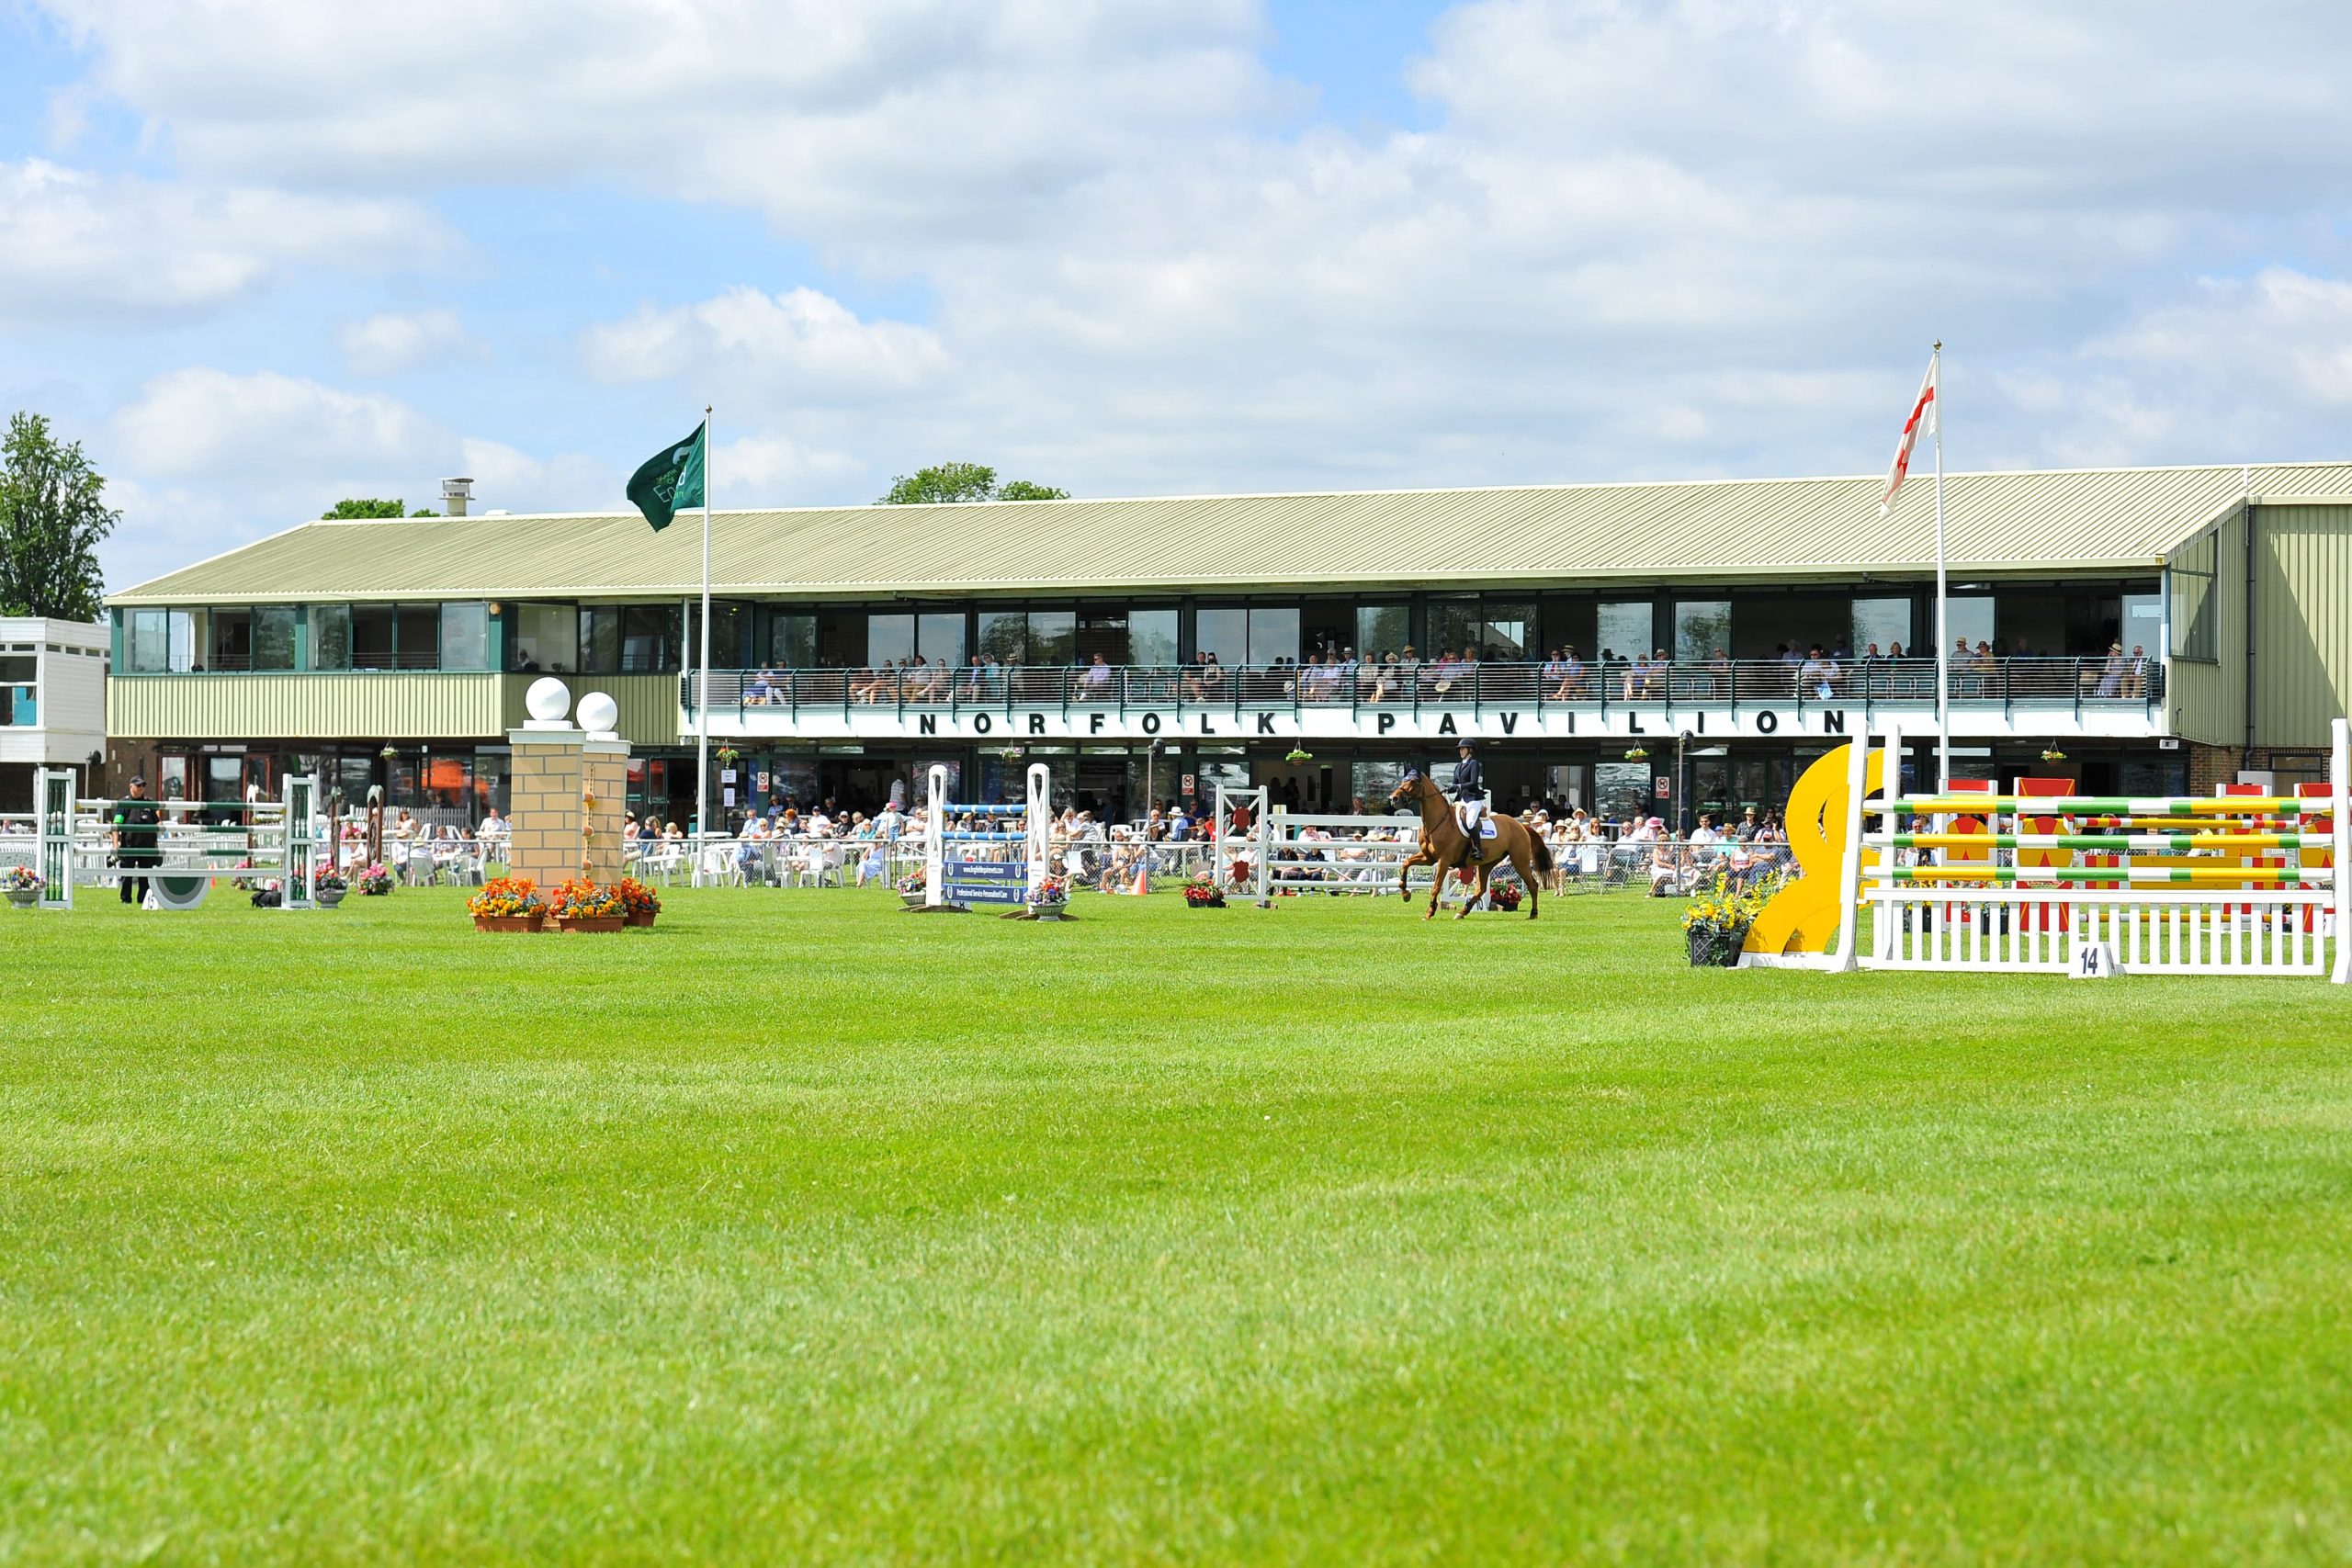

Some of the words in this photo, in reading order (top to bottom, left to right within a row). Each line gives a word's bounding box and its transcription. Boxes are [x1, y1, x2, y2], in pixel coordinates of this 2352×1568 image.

[920, 712, 1275, 735] NORFOLK
[1377, 711, 1844, 735] PAVILION
[2081, 947, 2098, 975] 14
